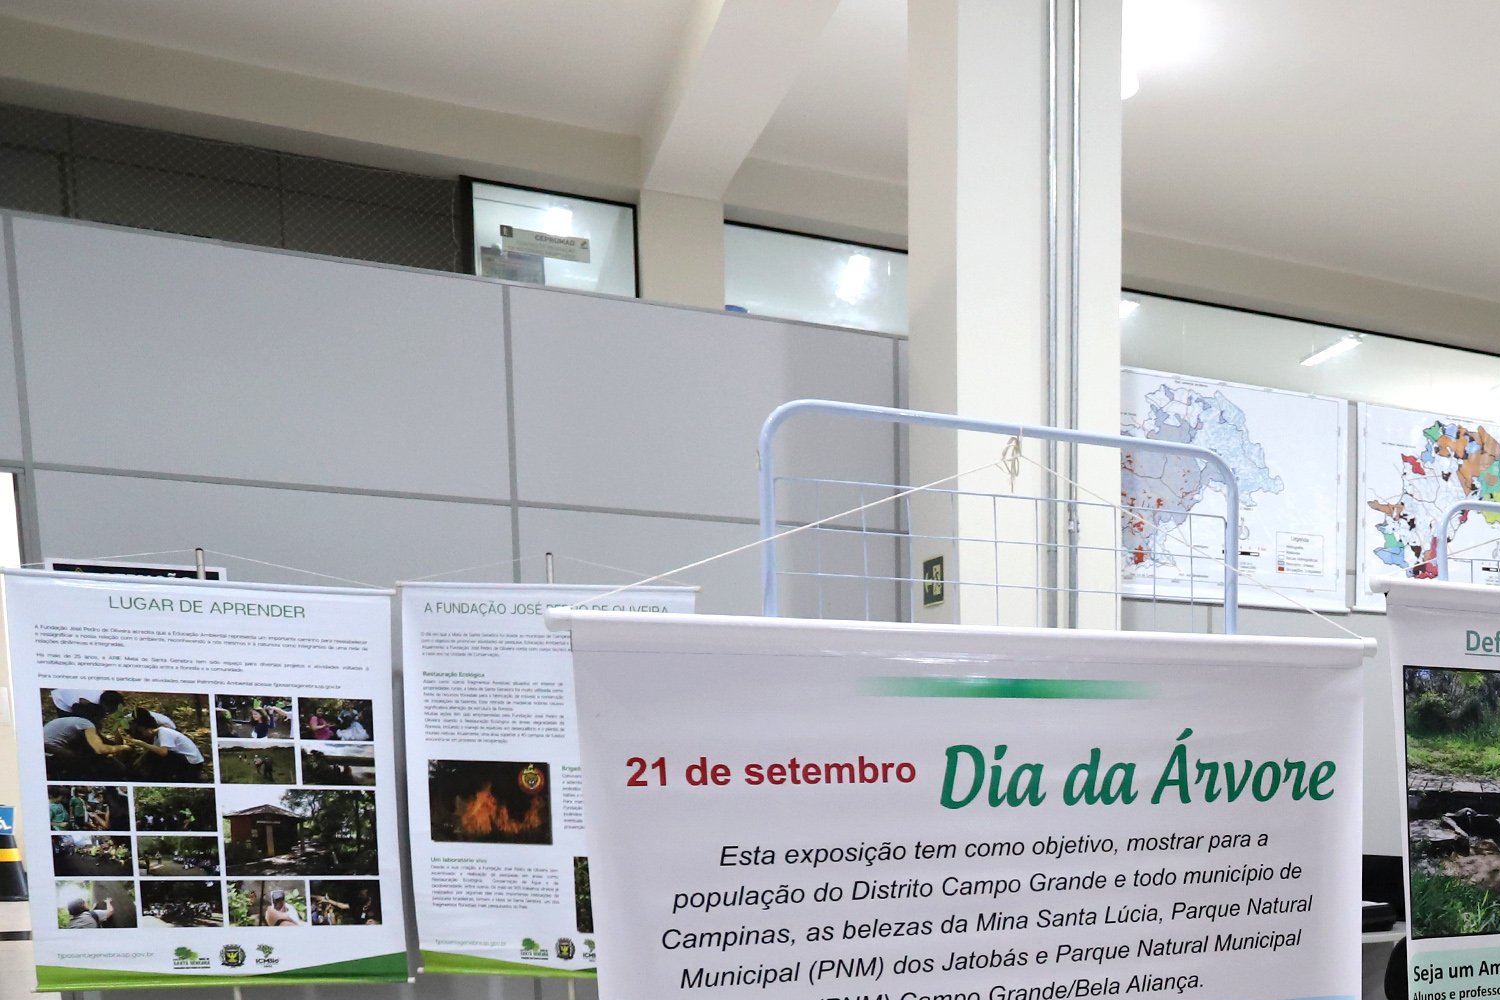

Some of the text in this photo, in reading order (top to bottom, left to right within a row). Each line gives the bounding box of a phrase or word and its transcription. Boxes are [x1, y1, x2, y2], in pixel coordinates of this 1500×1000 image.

[109, 596, 305, 618] LUGAR DE APRENDER
[424, 602, 432, 613] A
[436, 600, 506, 616] FUNDAÇÃO
[511, 602, 542, 615] JOSÉ
[626, 756, 915, 786] 21 de setembro
[940, 728, 1336, 809] Dia da Árvore
[720, 833, 1268, 868] Esta exposição tem como objetivo, mostrar para a
[673, 862, 1301, 914] população do Distrito Campo Grande e todo município de
[662, 895, 1312, 951] Campinas, as belezas da Mina Santa Lúcia, Parque Natural
[681, 929, 1301, 989] Municipal (PNM) dos Jatobás e Parque Natural Municipal
[1414, 964, 1443, 984] Seja
[1449, 965, 1473, 978] um
[1126, 974, 1203, 994] Aliança.
